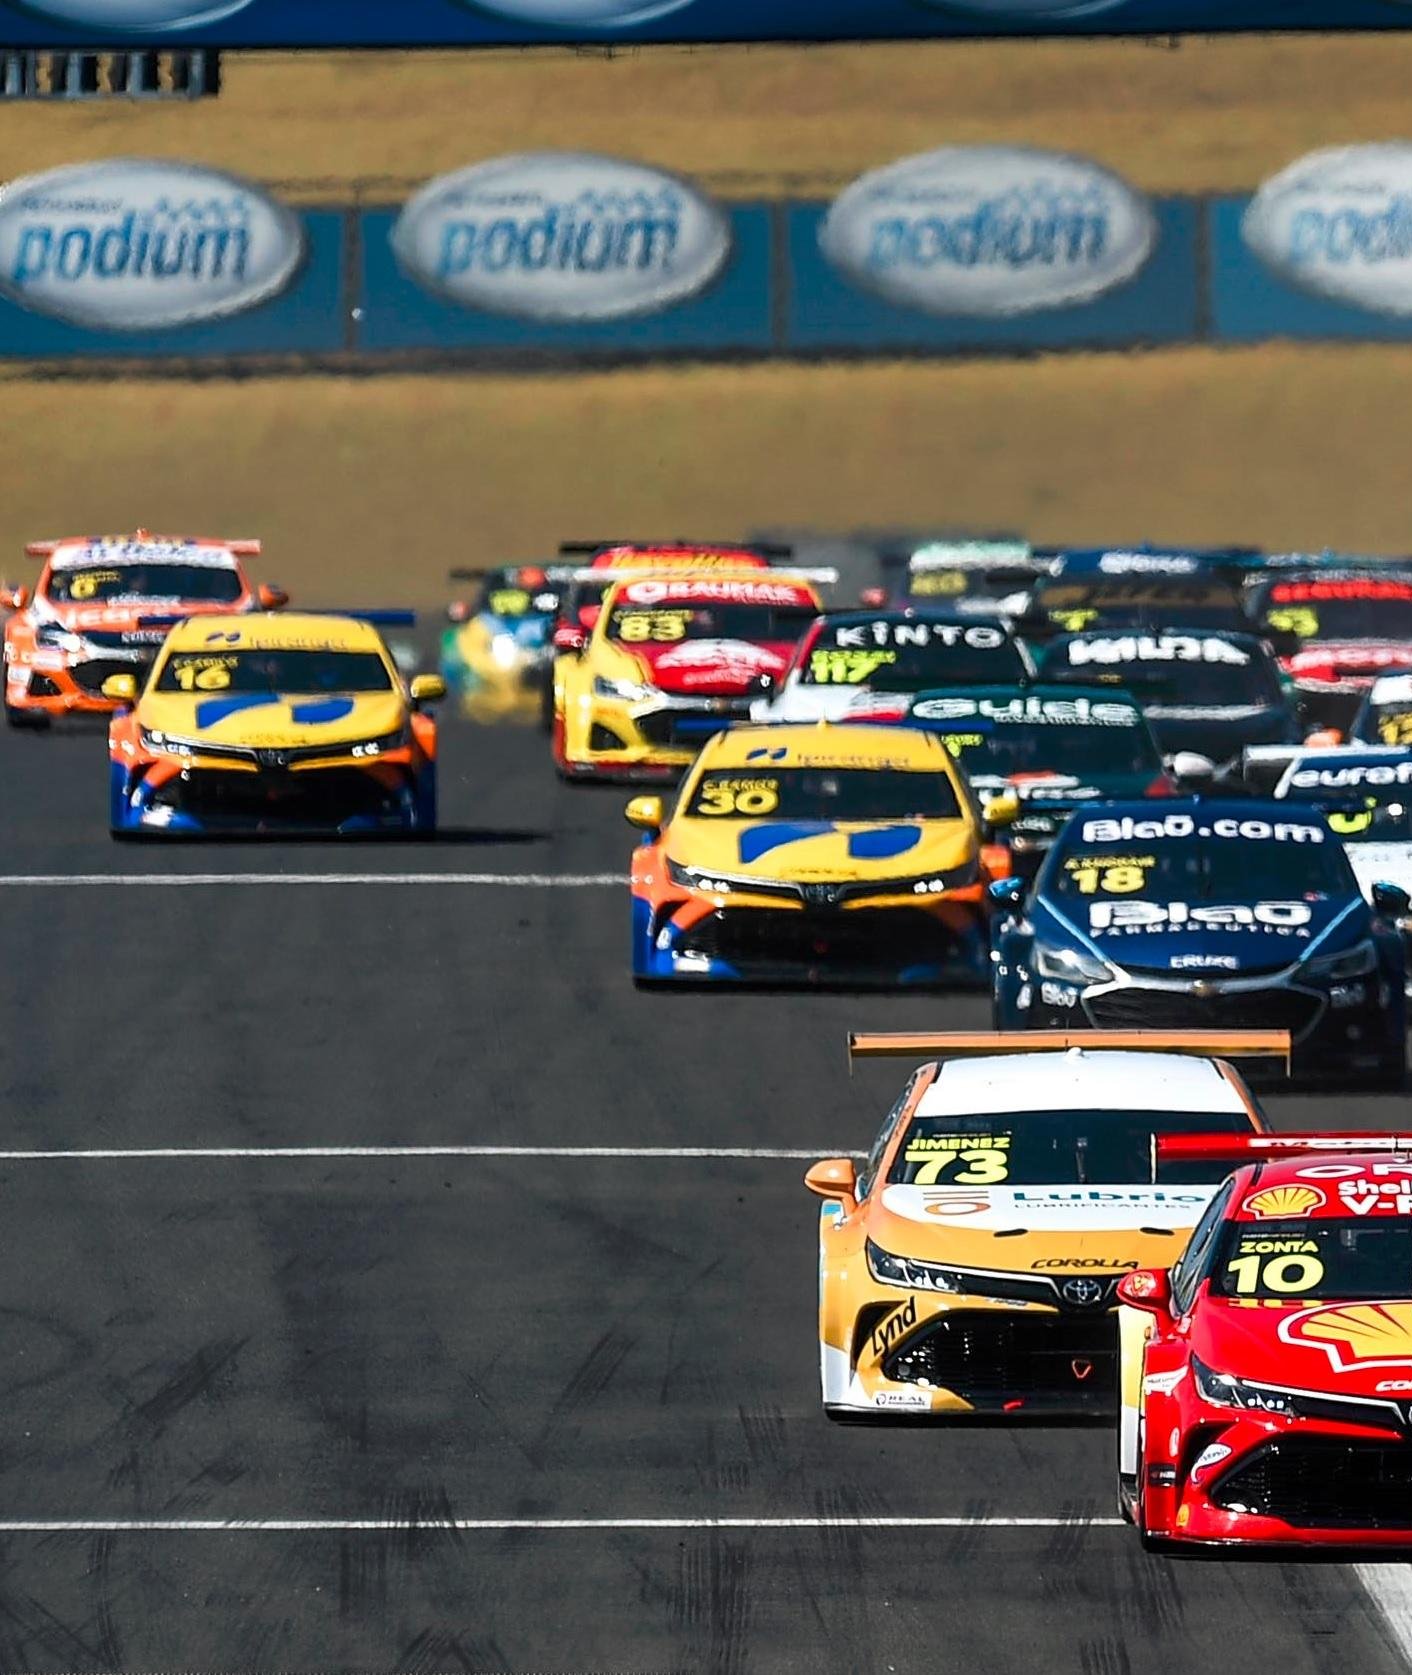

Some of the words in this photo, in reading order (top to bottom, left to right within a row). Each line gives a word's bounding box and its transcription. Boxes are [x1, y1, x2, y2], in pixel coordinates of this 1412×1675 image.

[13, 211, 252, 283] podium
[437, 209, 682, 275] podium
[619, 613, 687, 642] 83
[836, 621, 1005, 648] KINTO
[811, 655, 879, 684] 117
[697, 789, 780, 815] 30
[1071, 867, 1146, 893] 18
[907, 1137, 1011, 1150] JIMENEZ
[904, 1150, 1009, 1185] 73
[1239, 1240, 1318, 1253] ZONTA
[1031, 1258, 1140, 1269] COROLLA
[1228, 1254, 1324, 1294] 10
[872, 1295, 917, 1358] Lynd
